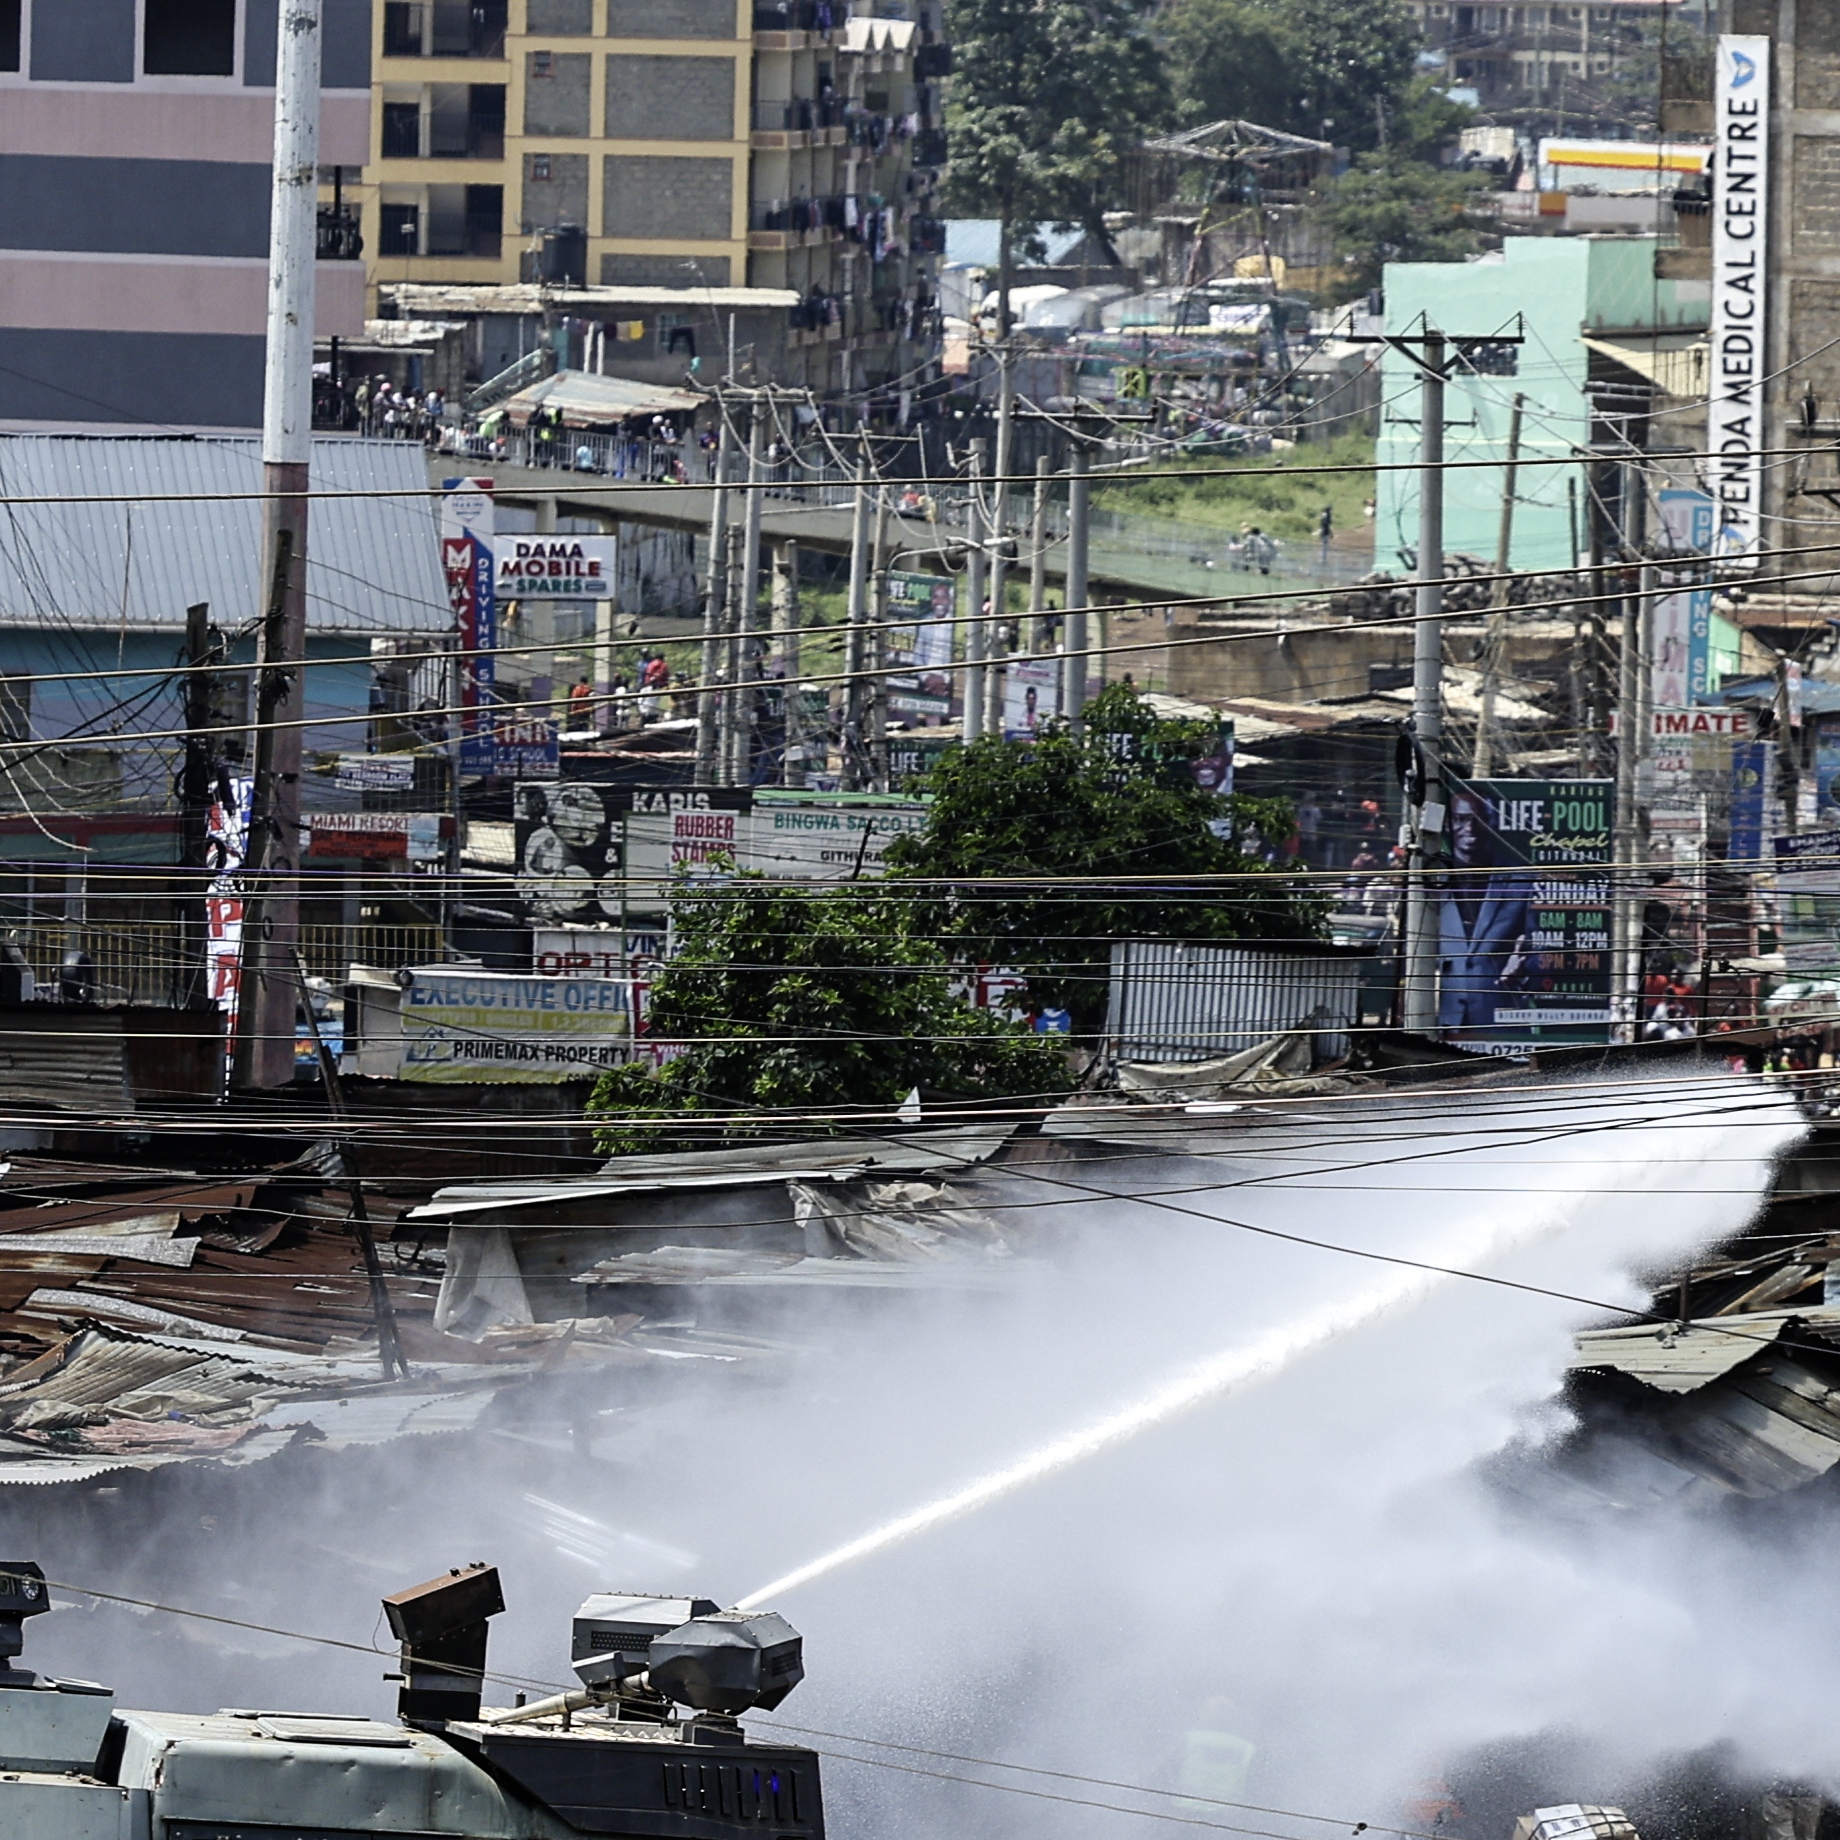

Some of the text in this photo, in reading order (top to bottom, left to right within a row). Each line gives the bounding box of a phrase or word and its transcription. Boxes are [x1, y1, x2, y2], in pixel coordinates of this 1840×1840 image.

[1724, 98, 1758, 240] CENTRE
[1721, 249, 1756, 405] MEDICAL
[515, 542, 584, 558] DAMA
[500, 560, 602, 577] MOBILE
[516, 579, 582, 593] SPARES
[477, 557, 491, 649] DRIVING
[632, 791, 711, 812] KARIS
[310, 815, 409, 831] MIAMI RESORT
[673, 814, 735, 839] RUBBER
[773, 812, 841, 830] BINGWA
[846, 815, 902, 831] SACCO
[1529, 831, 1609, 850] Chapel
[1532, 879, 1609, 905] SUNDAY
[1538, 911, 1566, 929] 6AM
[1576, 911, 1603, 929] 8AM
[409, 980, 557, 1010] EXECUTIVE
[452, 1041, 629, 1065] PRIMEMAX PROPERTY
